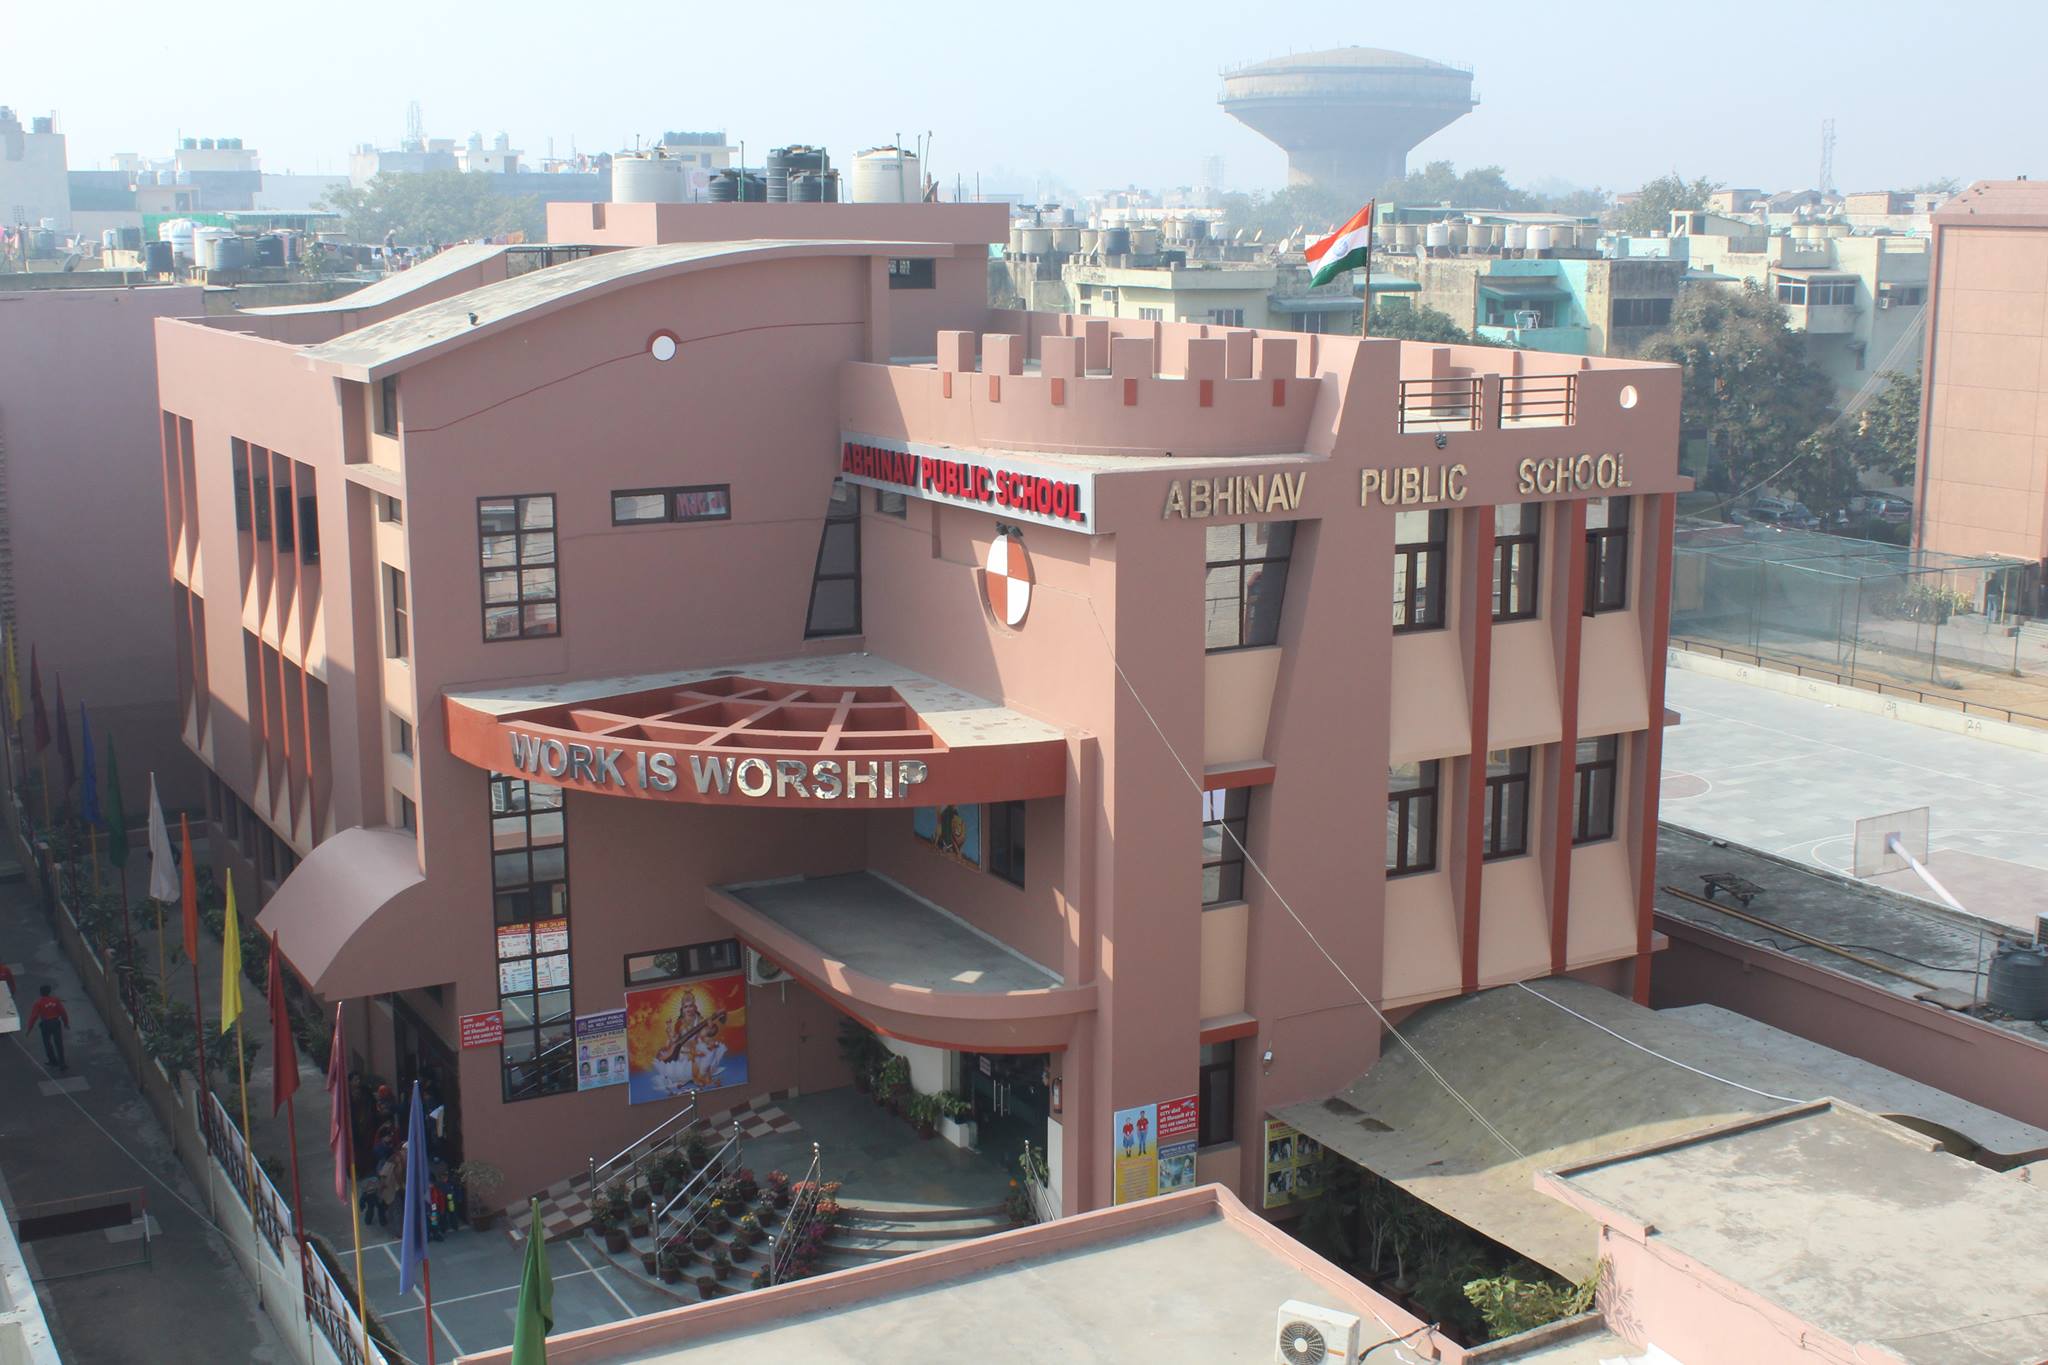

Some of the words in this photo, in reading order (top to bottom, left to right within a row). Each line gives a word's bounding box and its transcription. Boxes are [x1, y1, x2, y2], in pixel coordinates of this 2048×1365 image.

[842, 442, 919, 487] ABHINAV
[921, 456, 994, 502] PUBLIC
[995, 469, 1086, 522] SCHOOL
[1163, 472, 1308, 520] ABHINAV
[1360, 463, 1468, 507] PUBLIC
[1519, 453, 1633, 495] SCHOOL
[508, 731, 626, 787] WORK
[635, 751, 678, 792] IS
[690, 756, 929, 799] WORSHIP
